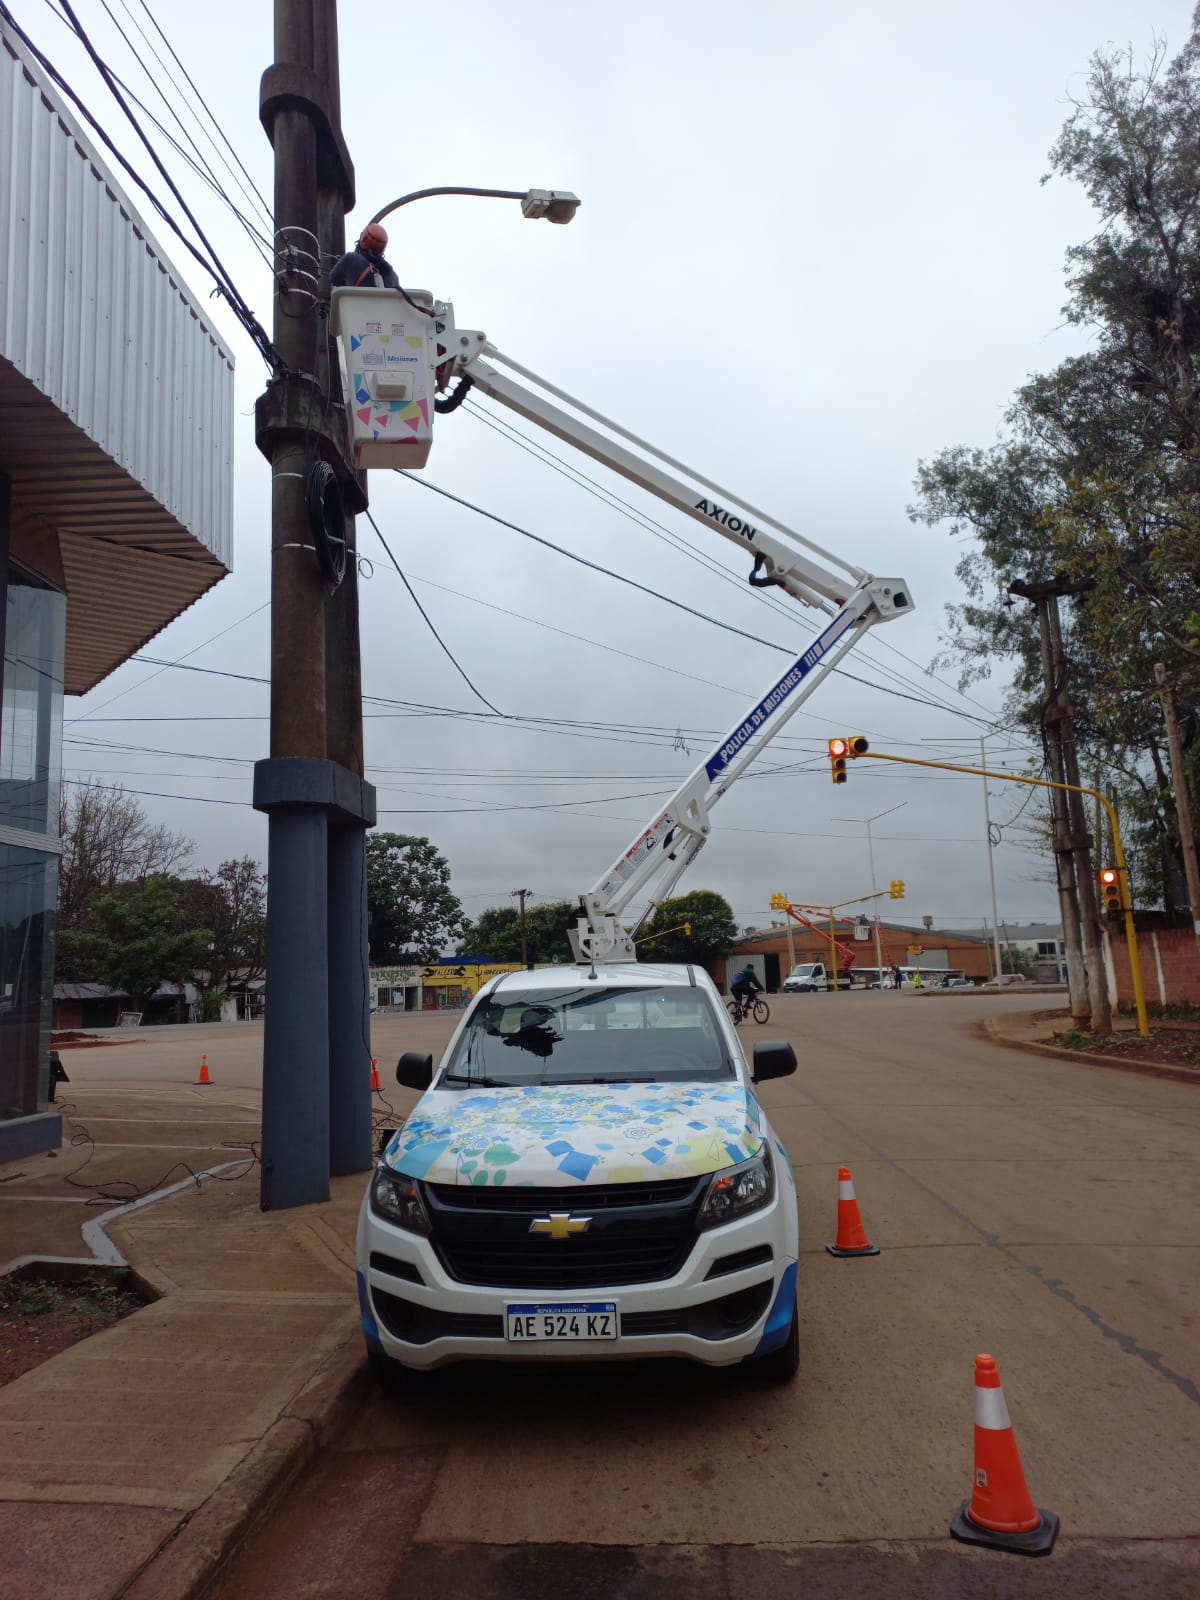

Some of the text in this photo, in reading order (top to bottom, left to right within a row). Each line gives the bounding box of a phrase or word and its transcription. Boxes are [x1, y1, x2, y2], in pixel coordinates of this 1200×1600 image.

[387, 355, 418, 363] Misiones
[694, 499, 757, 541] AXION
[720, 667, 802, 761] POLICIA DE MISIONES
[514, 1315, 611, 1337] AE 524 KZ
